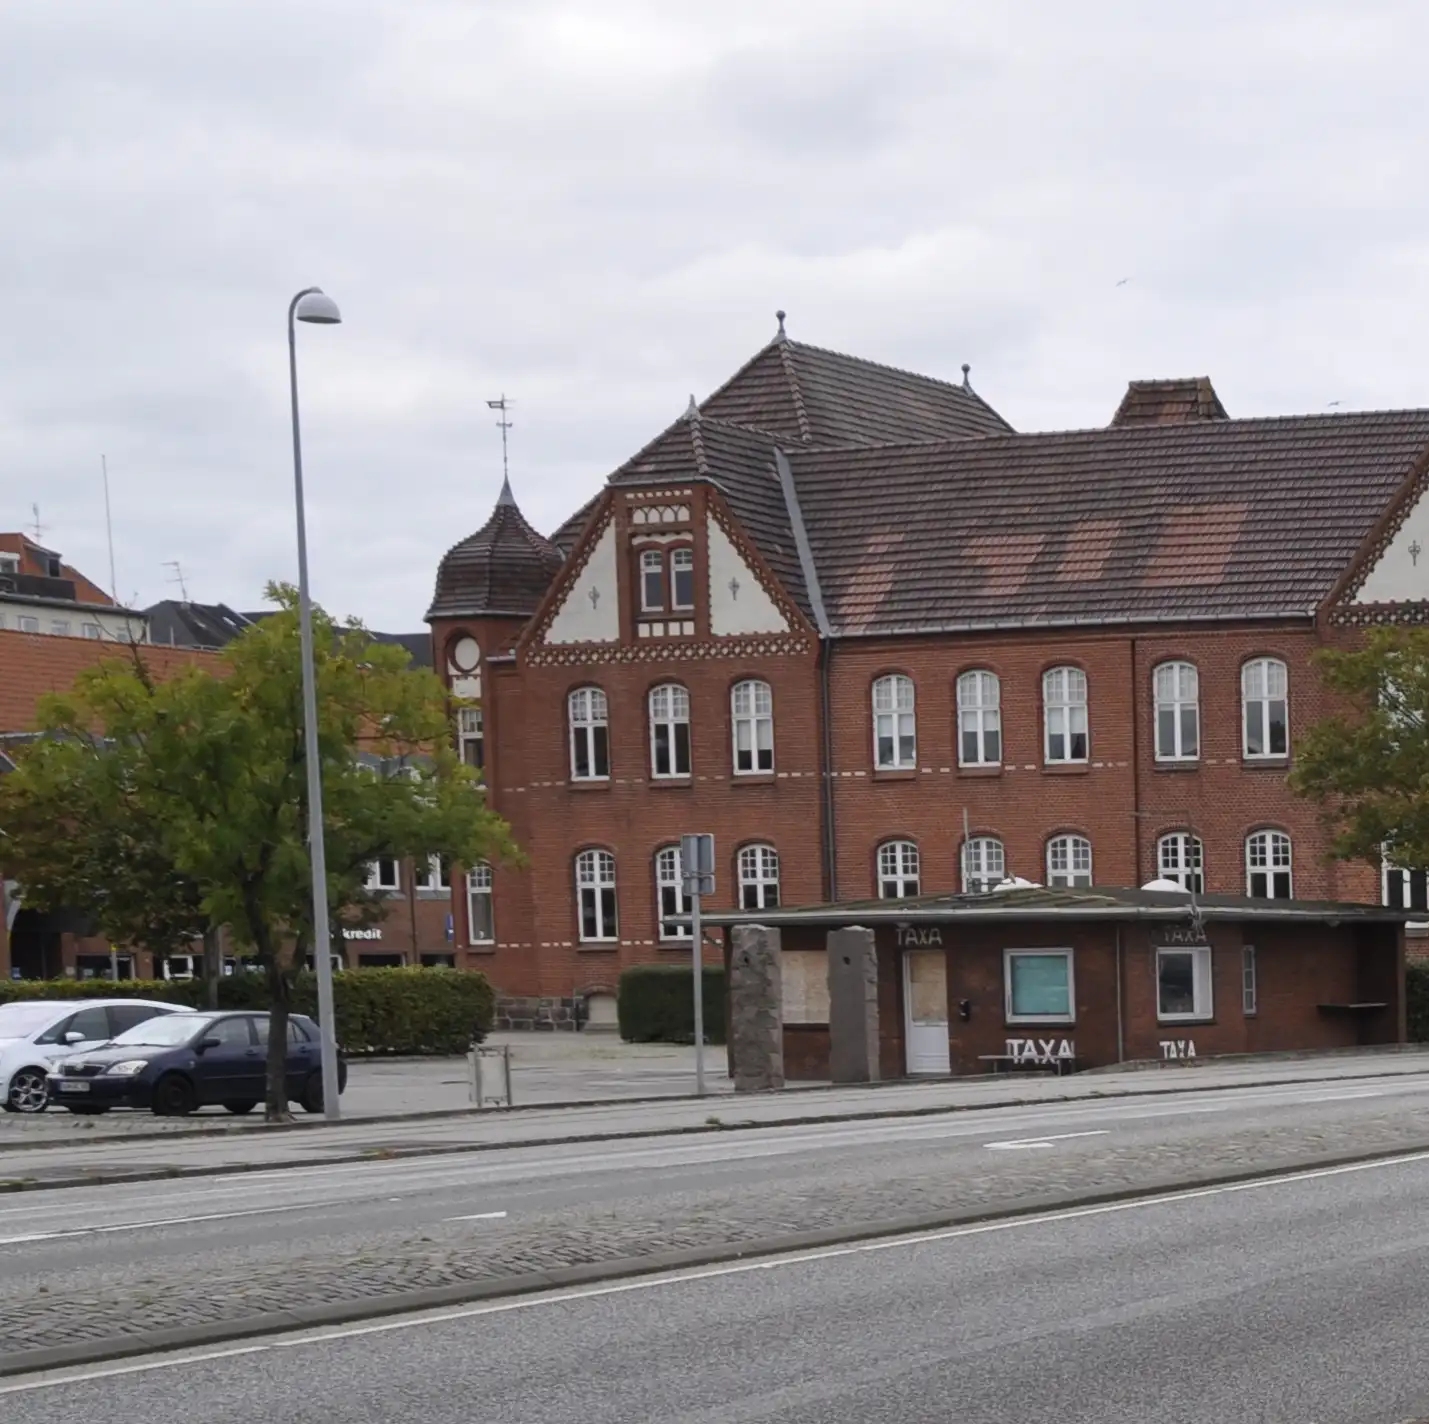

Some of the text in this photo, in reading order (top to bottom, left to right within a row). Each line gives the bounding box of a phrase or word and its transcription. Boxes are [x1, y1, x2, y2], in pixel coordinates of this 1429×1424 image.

[341, 928, 382, 940] kredit
[896, 927, 943, 945] TAXA
[1164, 926, 1207, 943] TAXA
[1006, 1039, 1075, 1065] TAXA
[1159, 1040, 1197, 1059] TAXA
